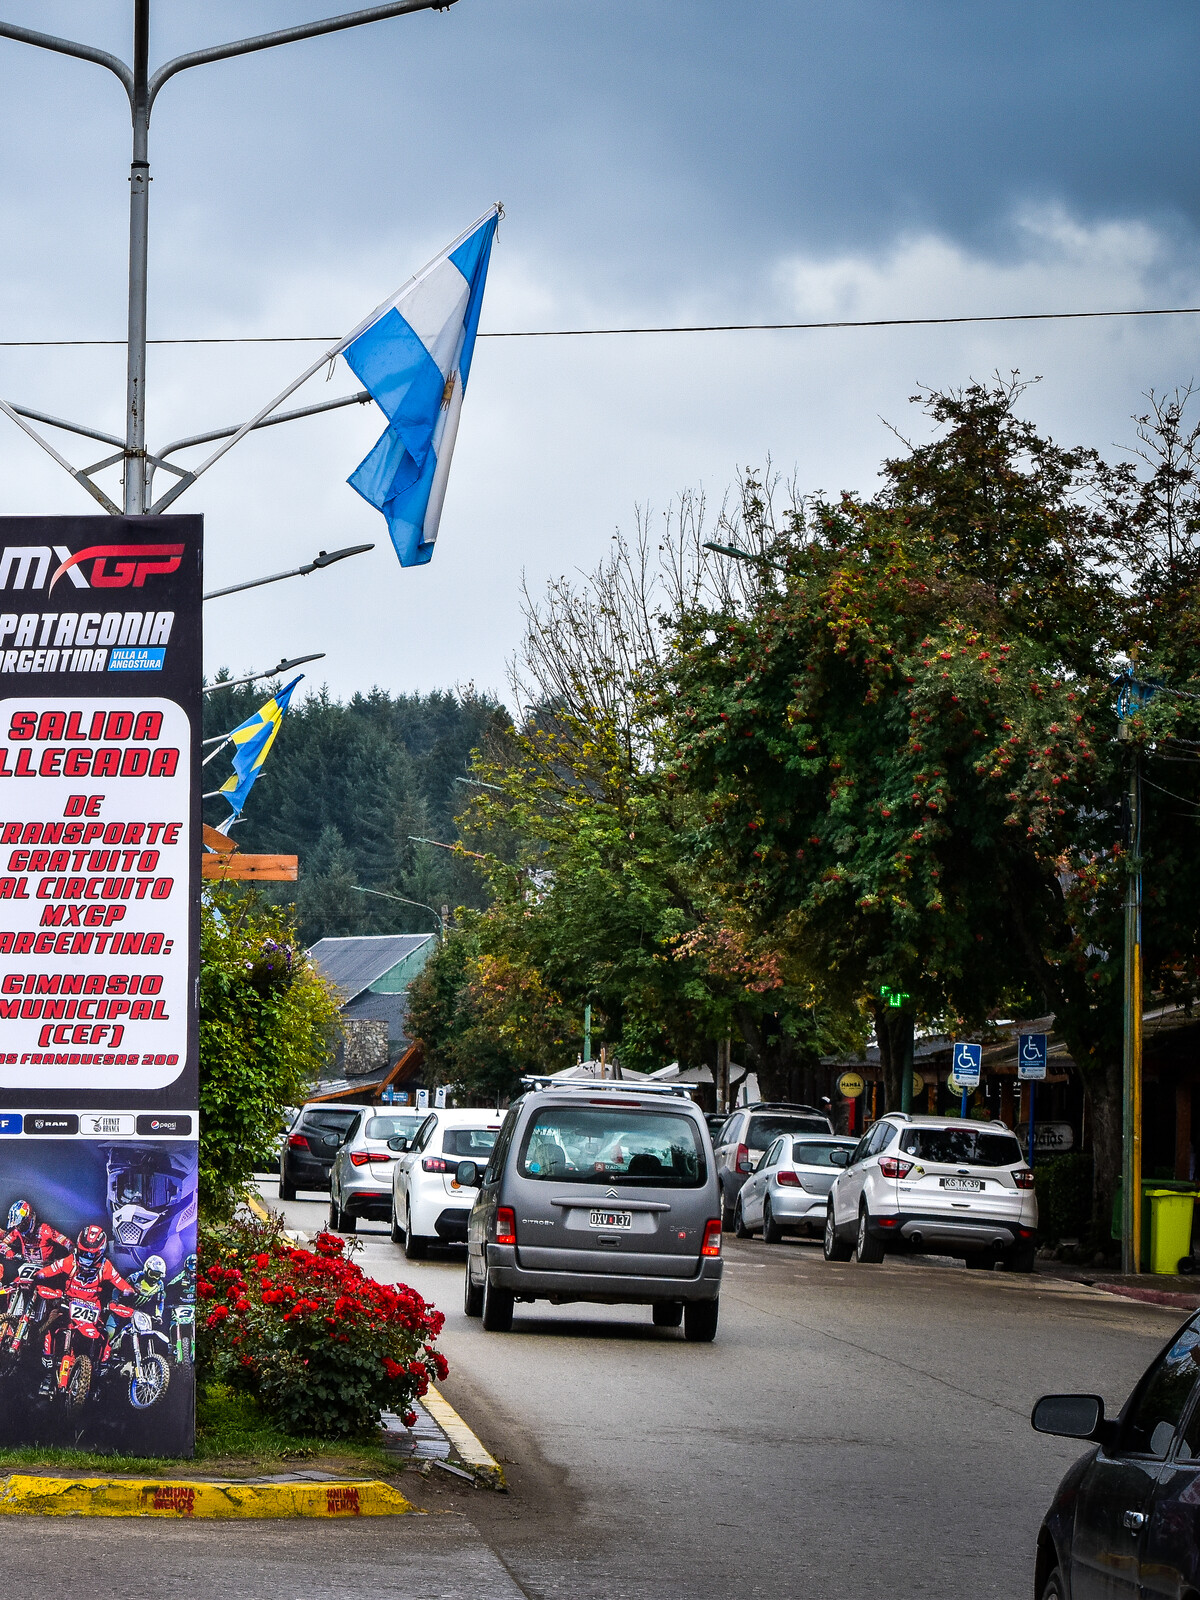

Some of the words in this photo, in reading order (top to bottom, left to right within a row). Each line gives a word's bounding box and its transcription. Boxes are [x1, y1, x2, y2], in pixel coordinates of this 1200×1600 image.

[110, 659, 162, 669] ANGOSTURA
[112, 651, 136, 660] VILLA
[137, 651, 149, 660] LA
[8, 711, 164, 741] SALIDA
[63, 795, 105, 817] DE
[7, 849, 160, 872] GRATUITO
[35, 877, 174, 900] CIRCUITO
[40, 905, 126, 926] MXGP
[1, 974, 163, 995] GIMNASIO
[20, 1053, 139, 1065] FRAMBUESAS
[141, 1054, 179, 1066] 200
[591, 1213, 608, 1224] OXV
[612, 1214, 630, 1226] 137
[71, 1306, 98, 1323] 243
